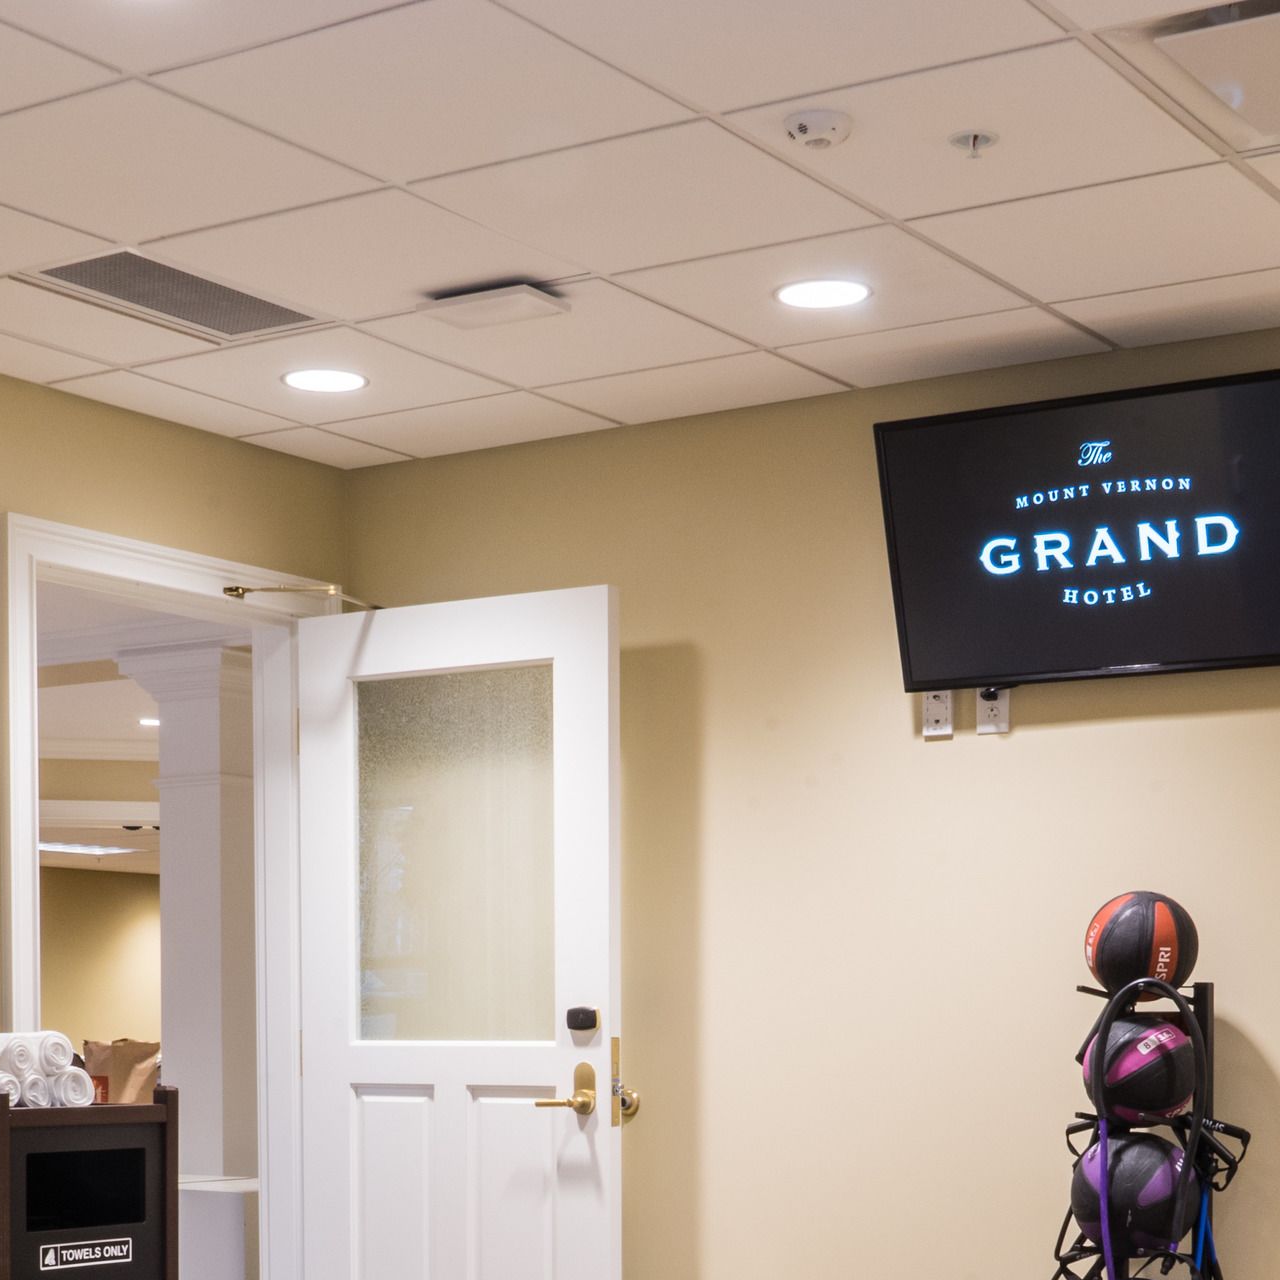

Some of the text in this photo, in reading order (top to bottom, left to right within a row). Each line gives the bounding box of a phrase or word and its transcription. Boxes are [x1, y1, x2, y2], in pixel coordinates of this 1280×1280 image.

[1078, 440, 1112, 466] The
[1016, 476, 1192, 509] MOUNT VERNON
[979, 514, 1240, 576] GRAND
[1063, 580, 1152, 605] HOTEL
[1155, 946, 1171, 980] SPRI
[61, 1244, 128, 1261] TOWELS ONLY
